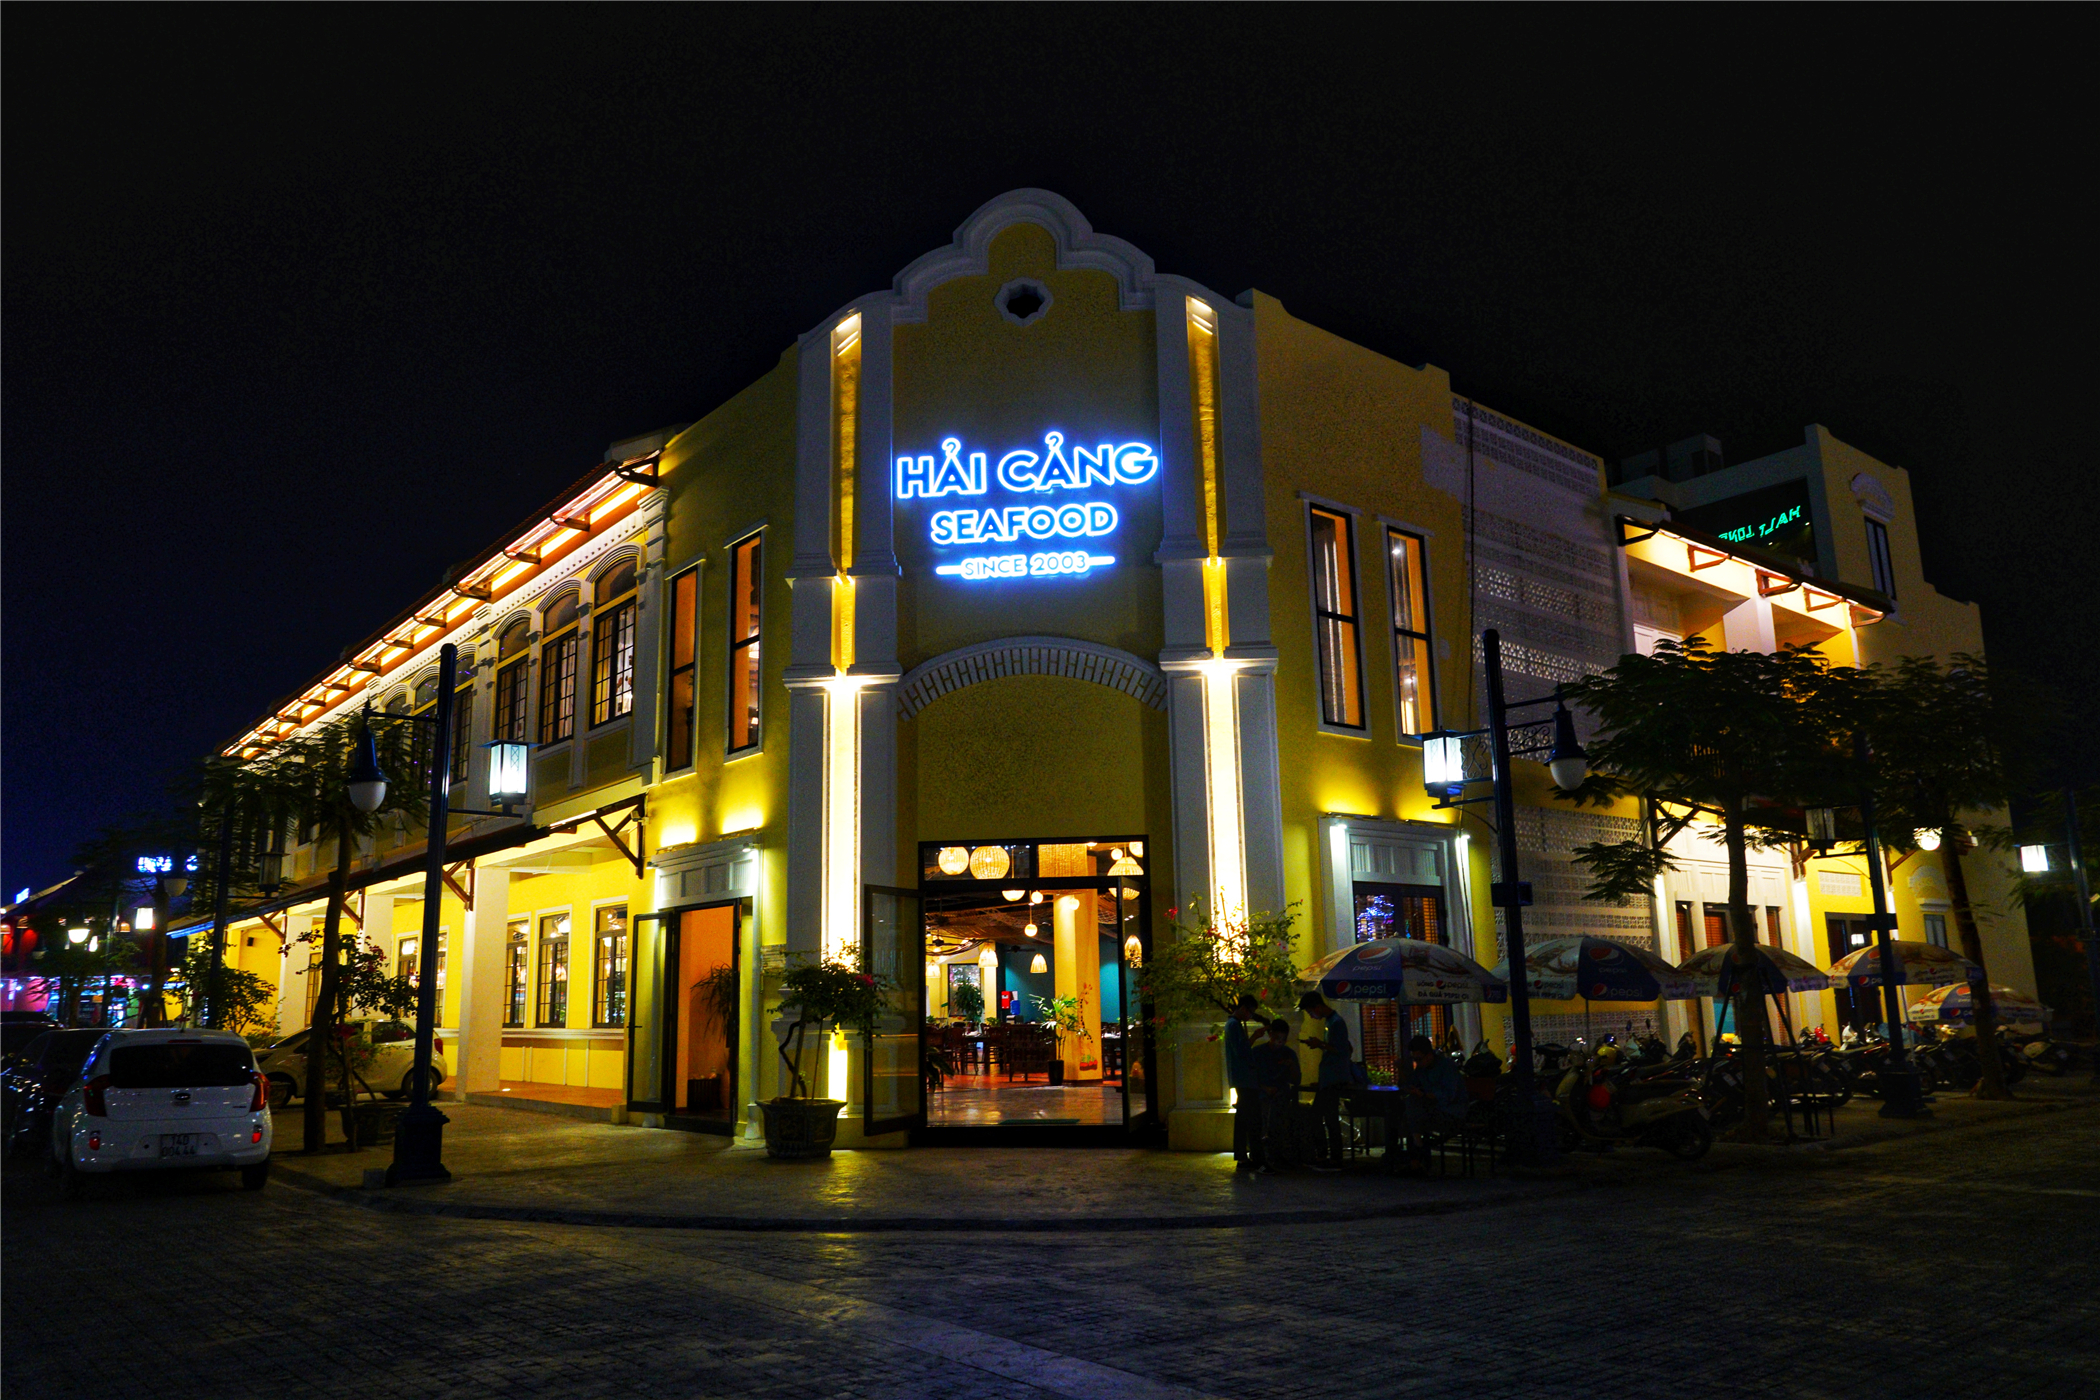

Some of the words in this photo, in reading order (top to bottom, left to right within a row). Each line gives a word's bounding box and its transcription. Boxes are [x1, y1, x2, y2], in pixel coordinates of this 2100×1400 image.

[897, 437, 986, 499] HẢI
[997, 431, 1158, 493] CẢNG
[931, 501, 1118, 545] SEAFOOD
[961, 554, 1027, 578] SINCE
[1030, 551, 1089, 576] 2003
[1352, 964, 1383, 972] pepsi
[1598, 966, 1628, 974] pepsi
[1353, 982, 1388, 996] pepsi
[1610, 987, 1643, 998] pepsi
